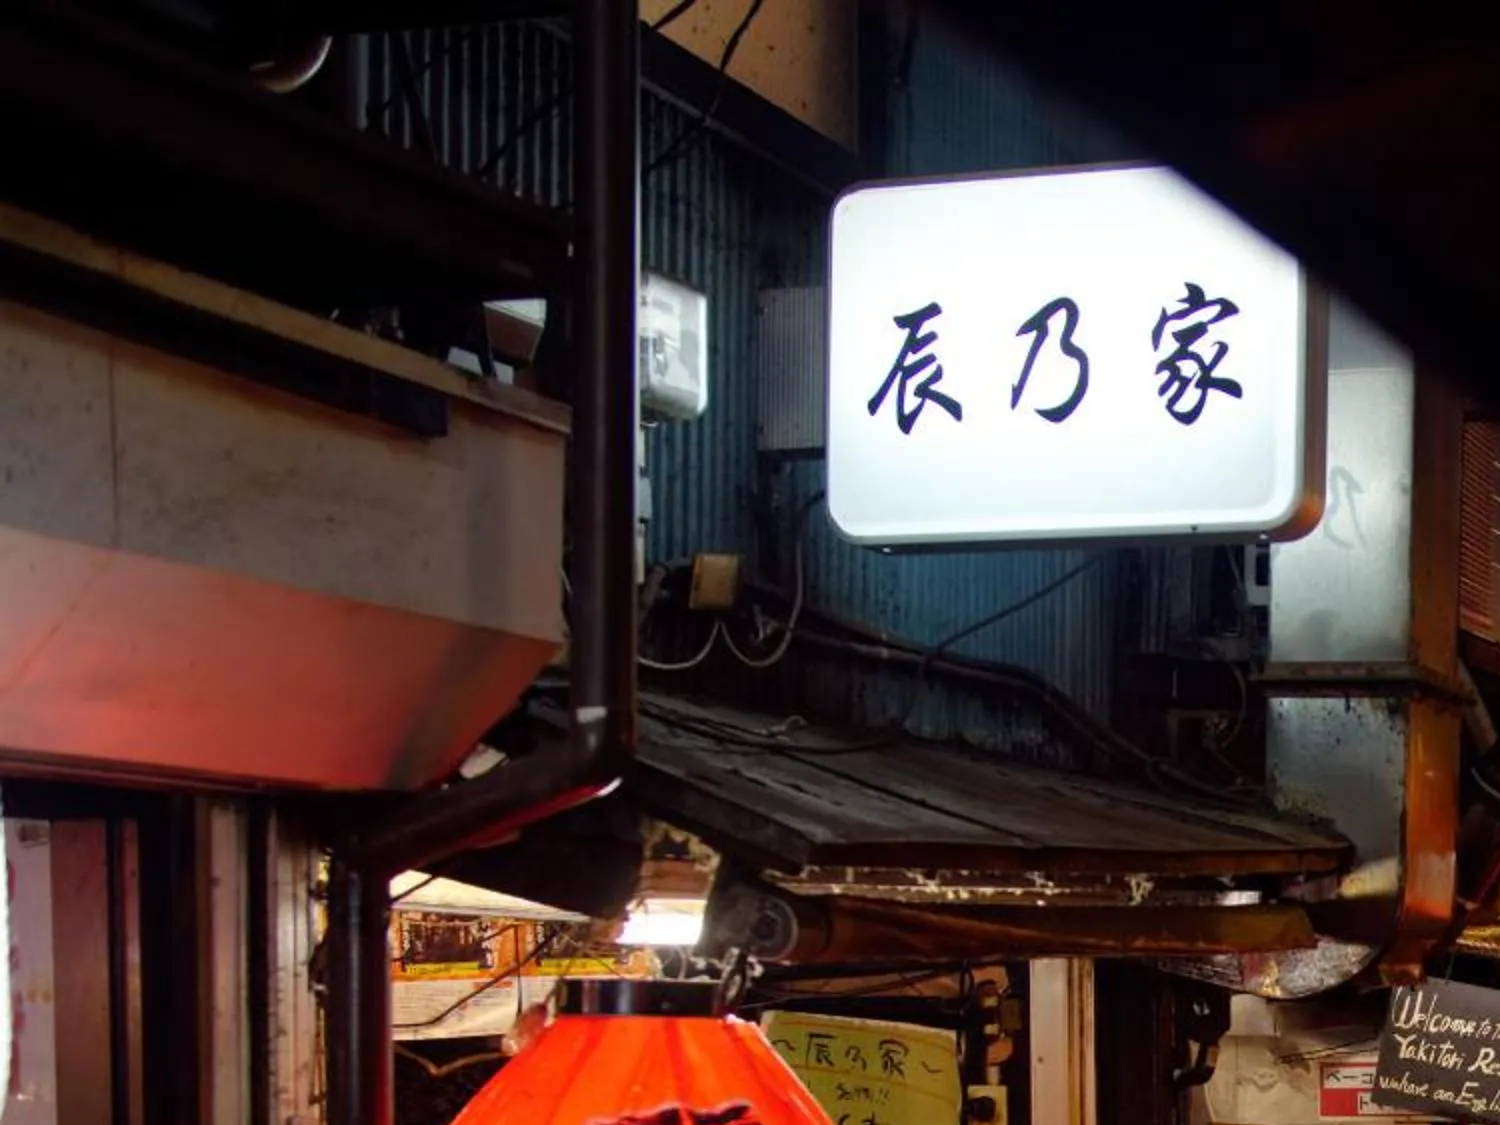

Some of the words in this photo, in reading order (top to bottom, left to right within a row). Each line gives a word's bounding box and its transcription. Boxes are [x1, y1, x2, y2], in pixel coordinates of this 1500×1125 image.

[867, 281, 1243, 435] 辰乃家
[1475, 1018, 1490, 1040] to
[1326, 1069, 1374, 1085] ベーコ
